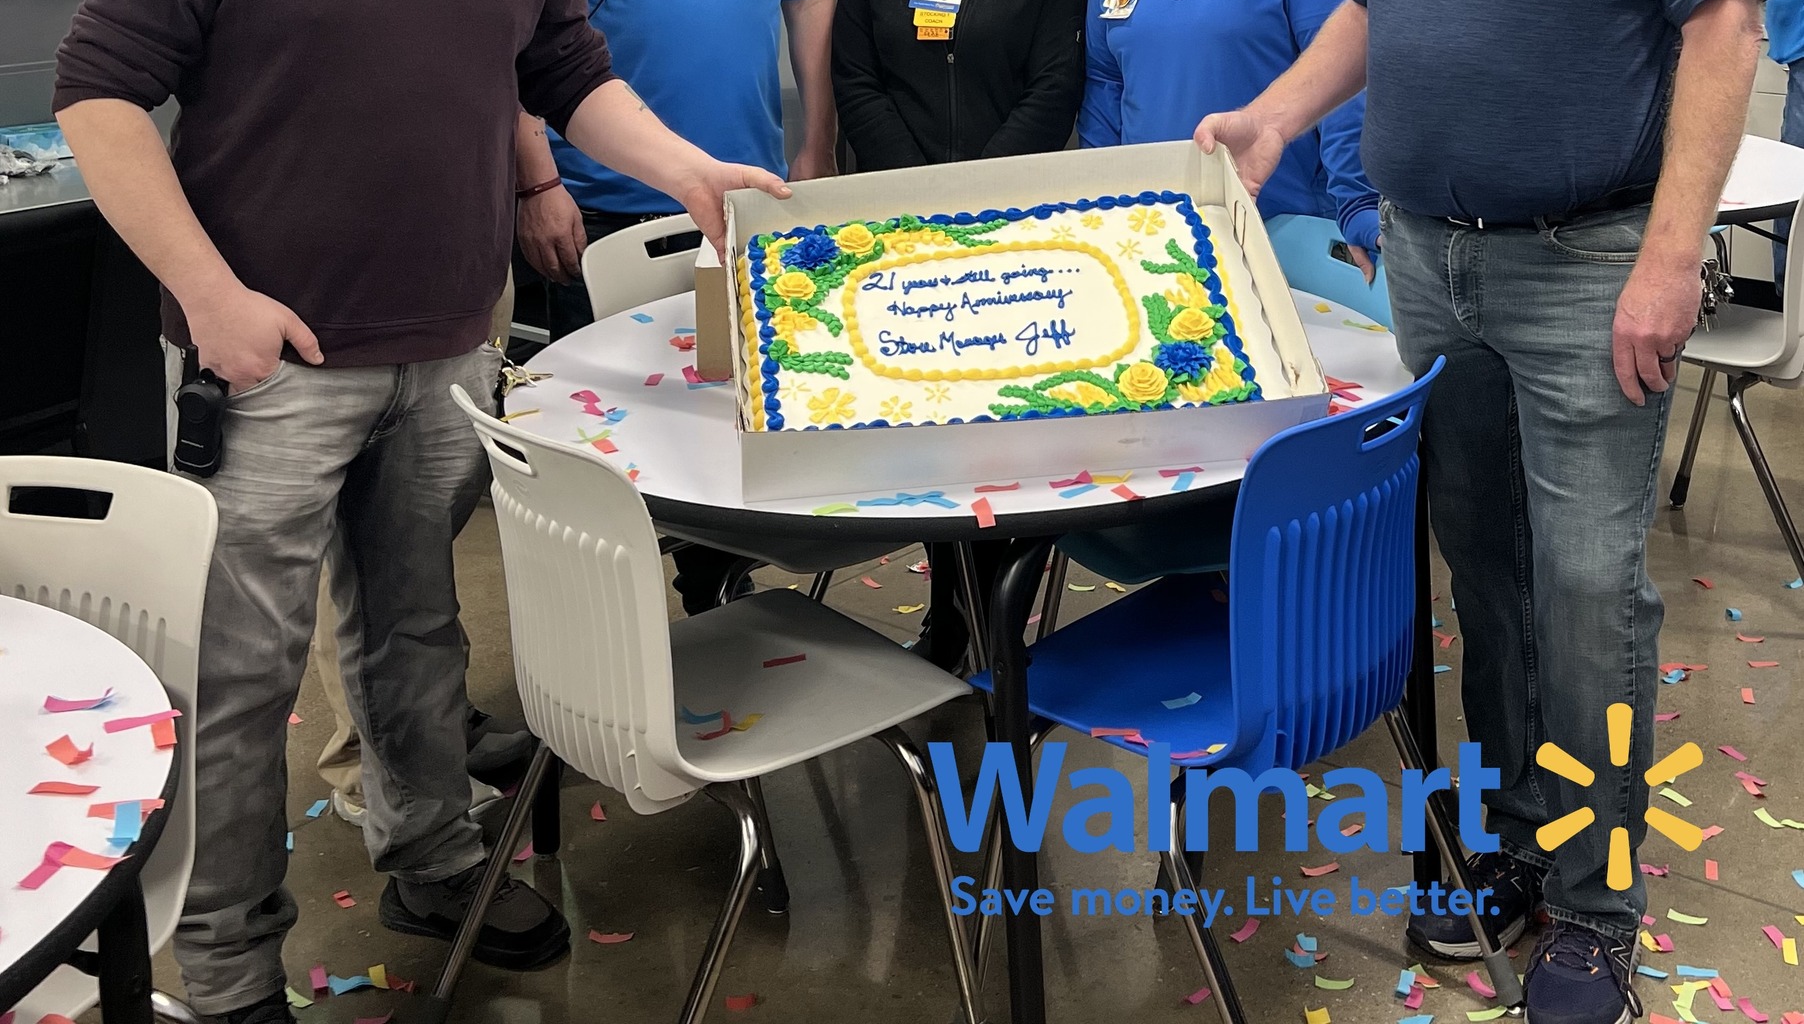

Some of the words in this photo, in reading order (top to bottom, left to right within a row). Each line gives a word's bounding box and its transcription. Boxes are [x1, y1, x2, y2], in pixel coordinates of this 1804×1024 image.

[862, 272, 896, 291] 21
[886, 300, 957, 322] Happy
[1014, 318, 1077, 356] Jeff
